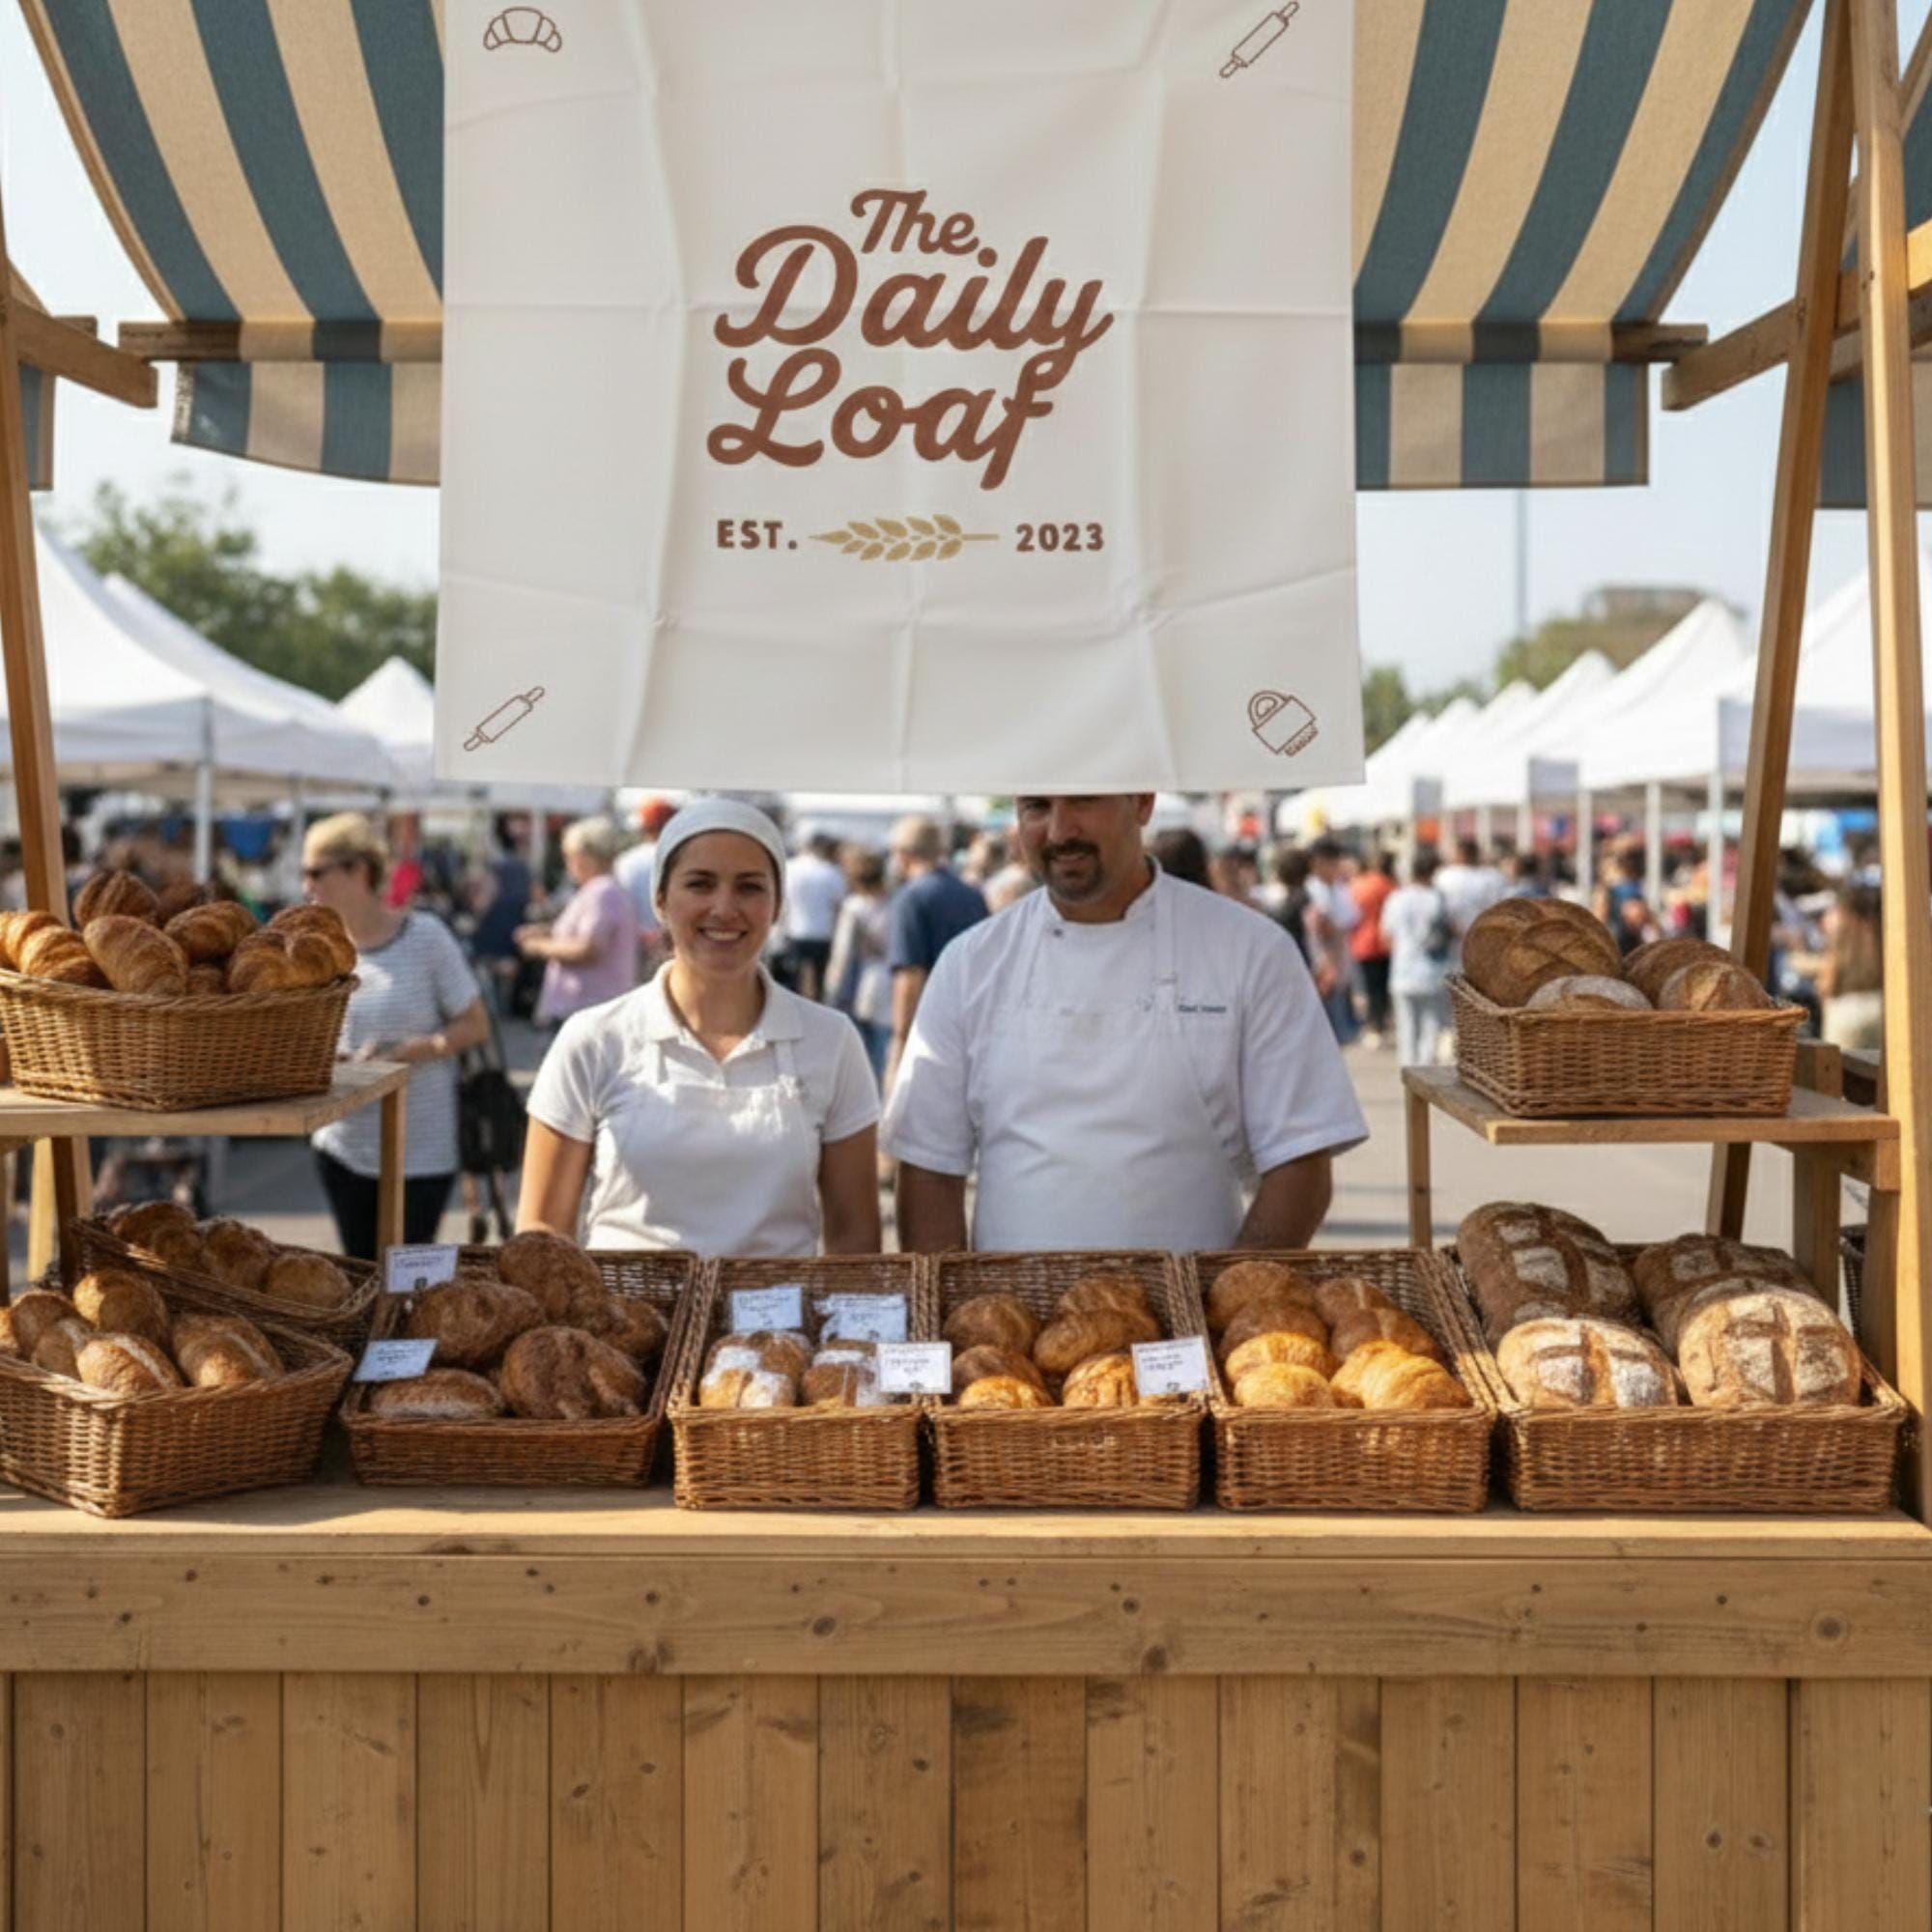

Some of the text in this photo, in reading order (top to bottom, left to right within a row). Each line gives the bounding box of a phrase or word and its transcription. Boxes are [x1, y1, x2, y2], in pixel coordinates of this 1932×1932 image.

[850, 188, 980, 255] The
[713, 224, 1115, 391] Daily
[706, 348, 1054, 491] Loaf
[716, 519, 1104, 552] EST. 2023
